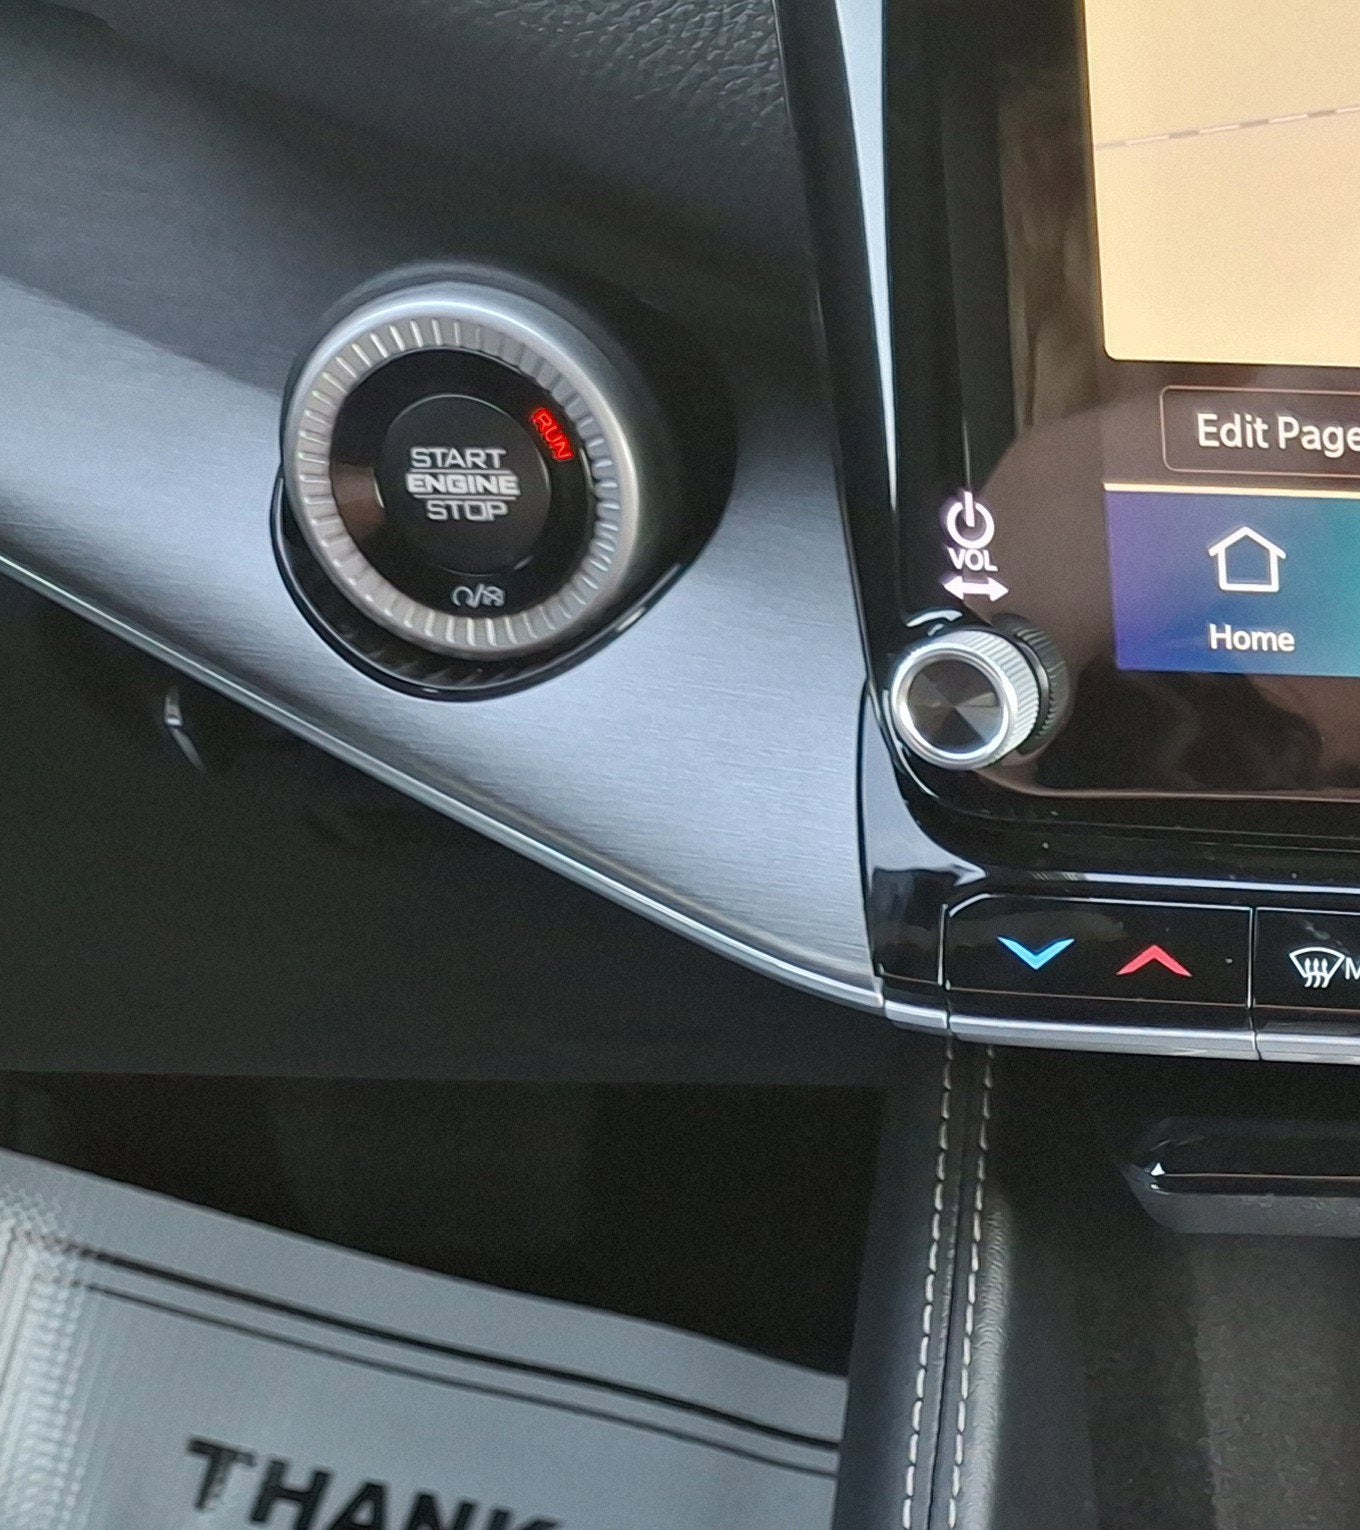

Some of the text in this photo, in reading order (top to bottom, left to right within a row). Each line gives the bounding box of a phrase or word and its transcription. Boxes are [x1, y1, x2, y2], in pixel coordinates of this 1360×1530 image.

[533, 407, 574, 461] RUN
[1198, 412, 1269, 449] Edit
[410, 447, 507, 469] START
[405, 473, 521, 496] ENGINE
[425, 501, 508, 521] STOP
[947, 547, 998, 573] VOL
[1208, 623, 1295, 653] Home
